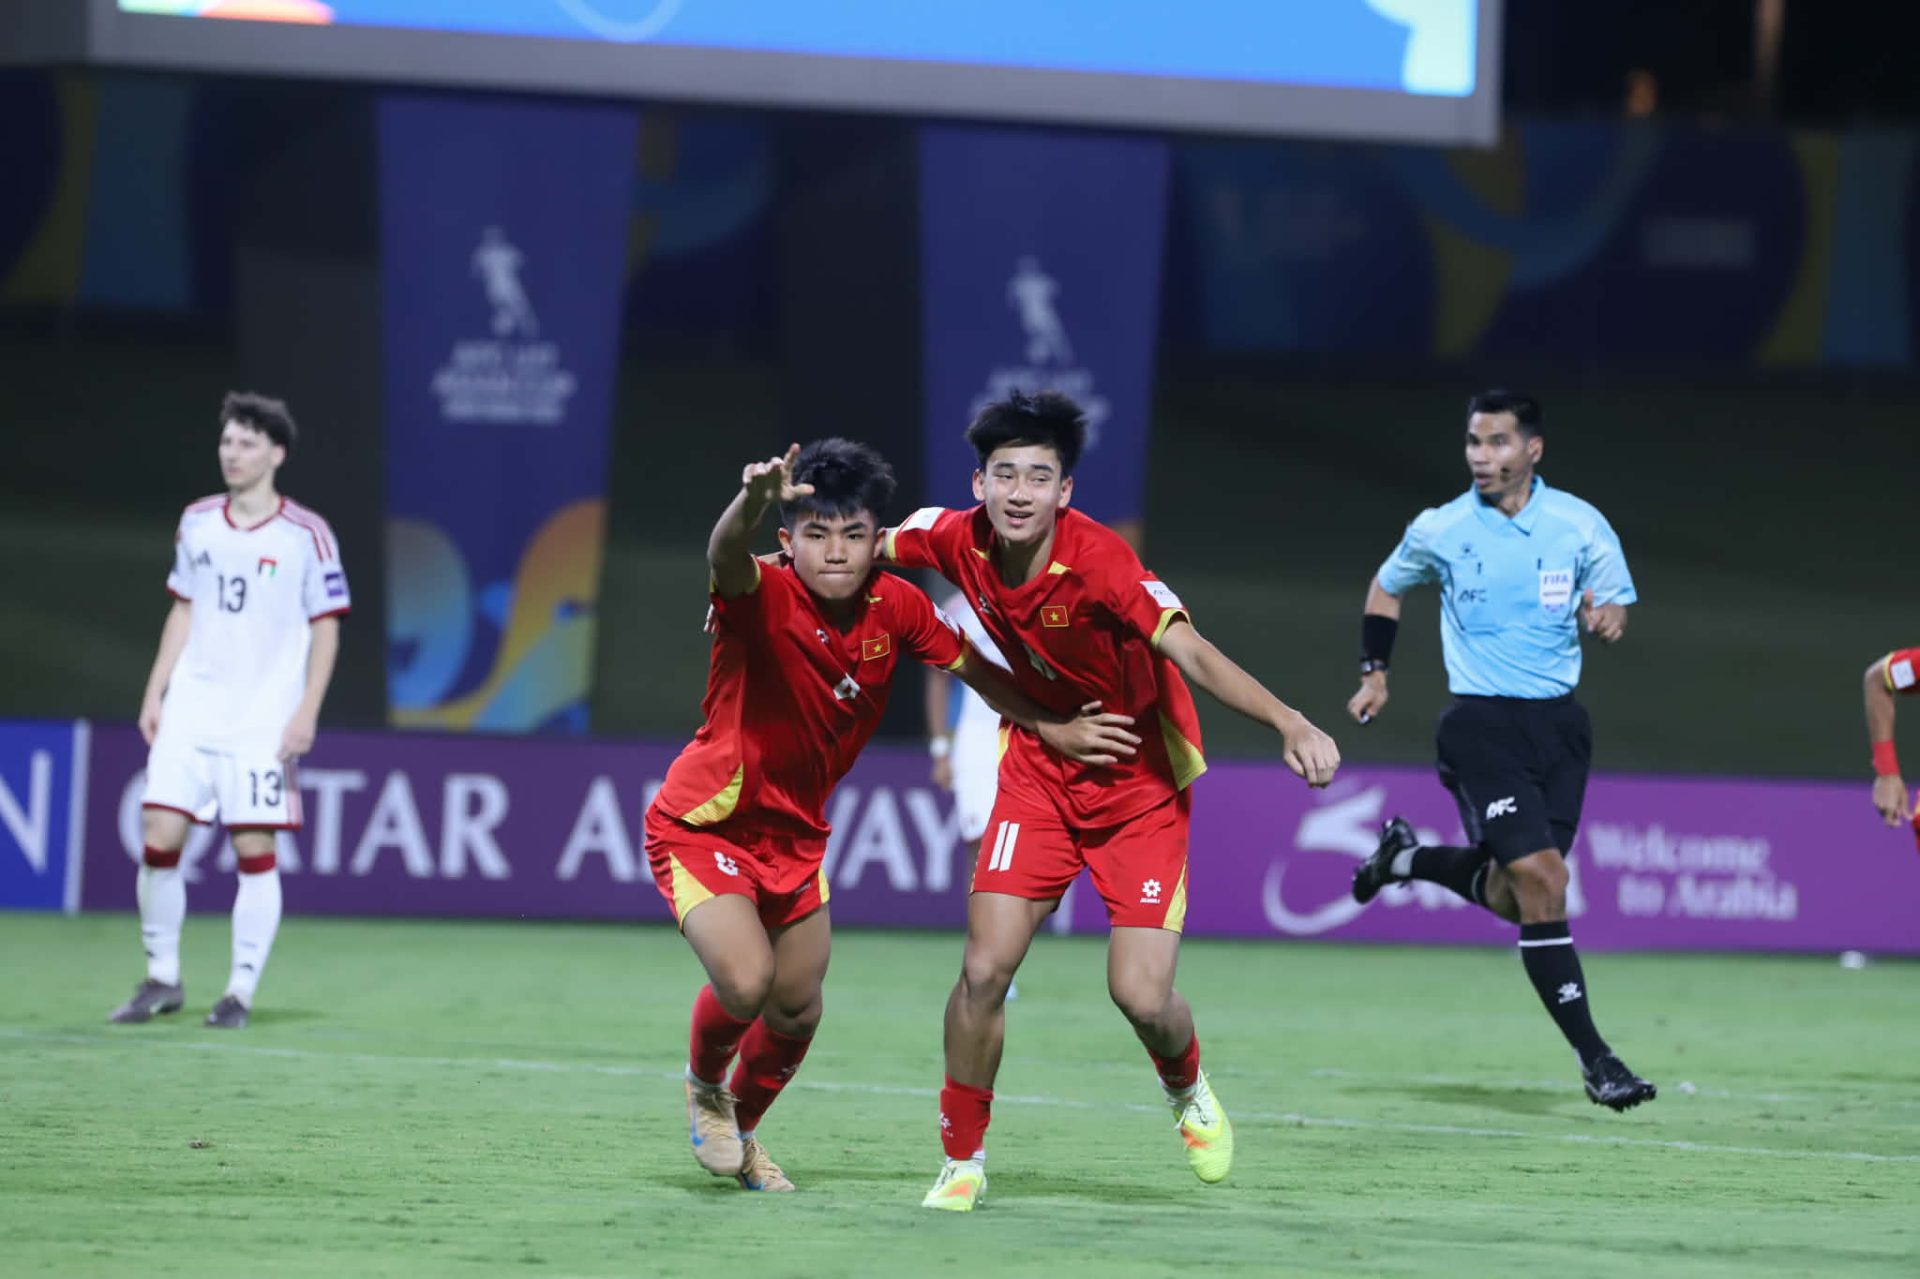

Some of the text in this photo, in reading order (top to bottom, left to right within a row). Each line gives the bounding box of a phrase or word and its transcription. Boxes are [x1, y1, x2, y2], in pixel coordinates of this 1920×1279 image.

[218, 574, 247, 613] 13
[1543, 574, 1569, 585] FIFA
[249, 771, 284, 806] 13
[1486, 796, 1518, 820] AFC
[988, 820, 1020, 872] 11
